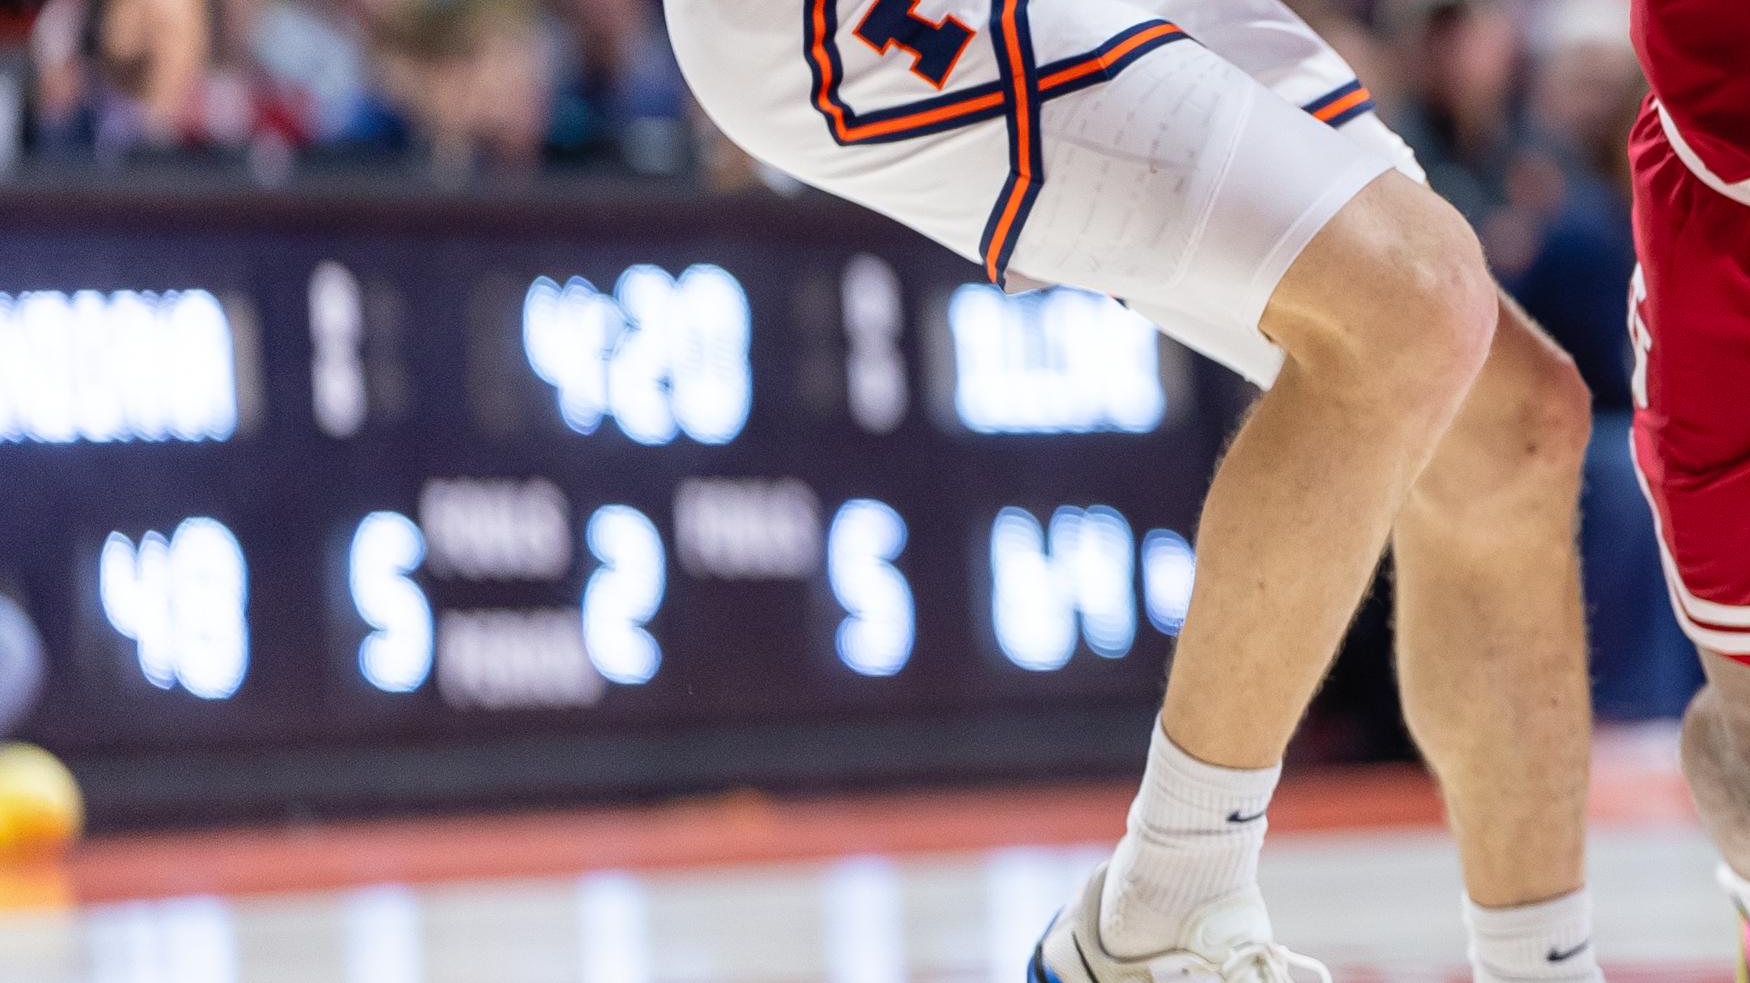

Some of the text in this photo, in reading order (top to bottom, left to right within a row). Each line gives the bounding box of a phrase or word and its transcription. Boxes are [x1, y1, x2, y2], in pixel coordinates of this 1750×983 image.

[349, 510, 435, 693] 5
[581, 503, 667, 685] 2
[827, 497, 916, 677] 5
